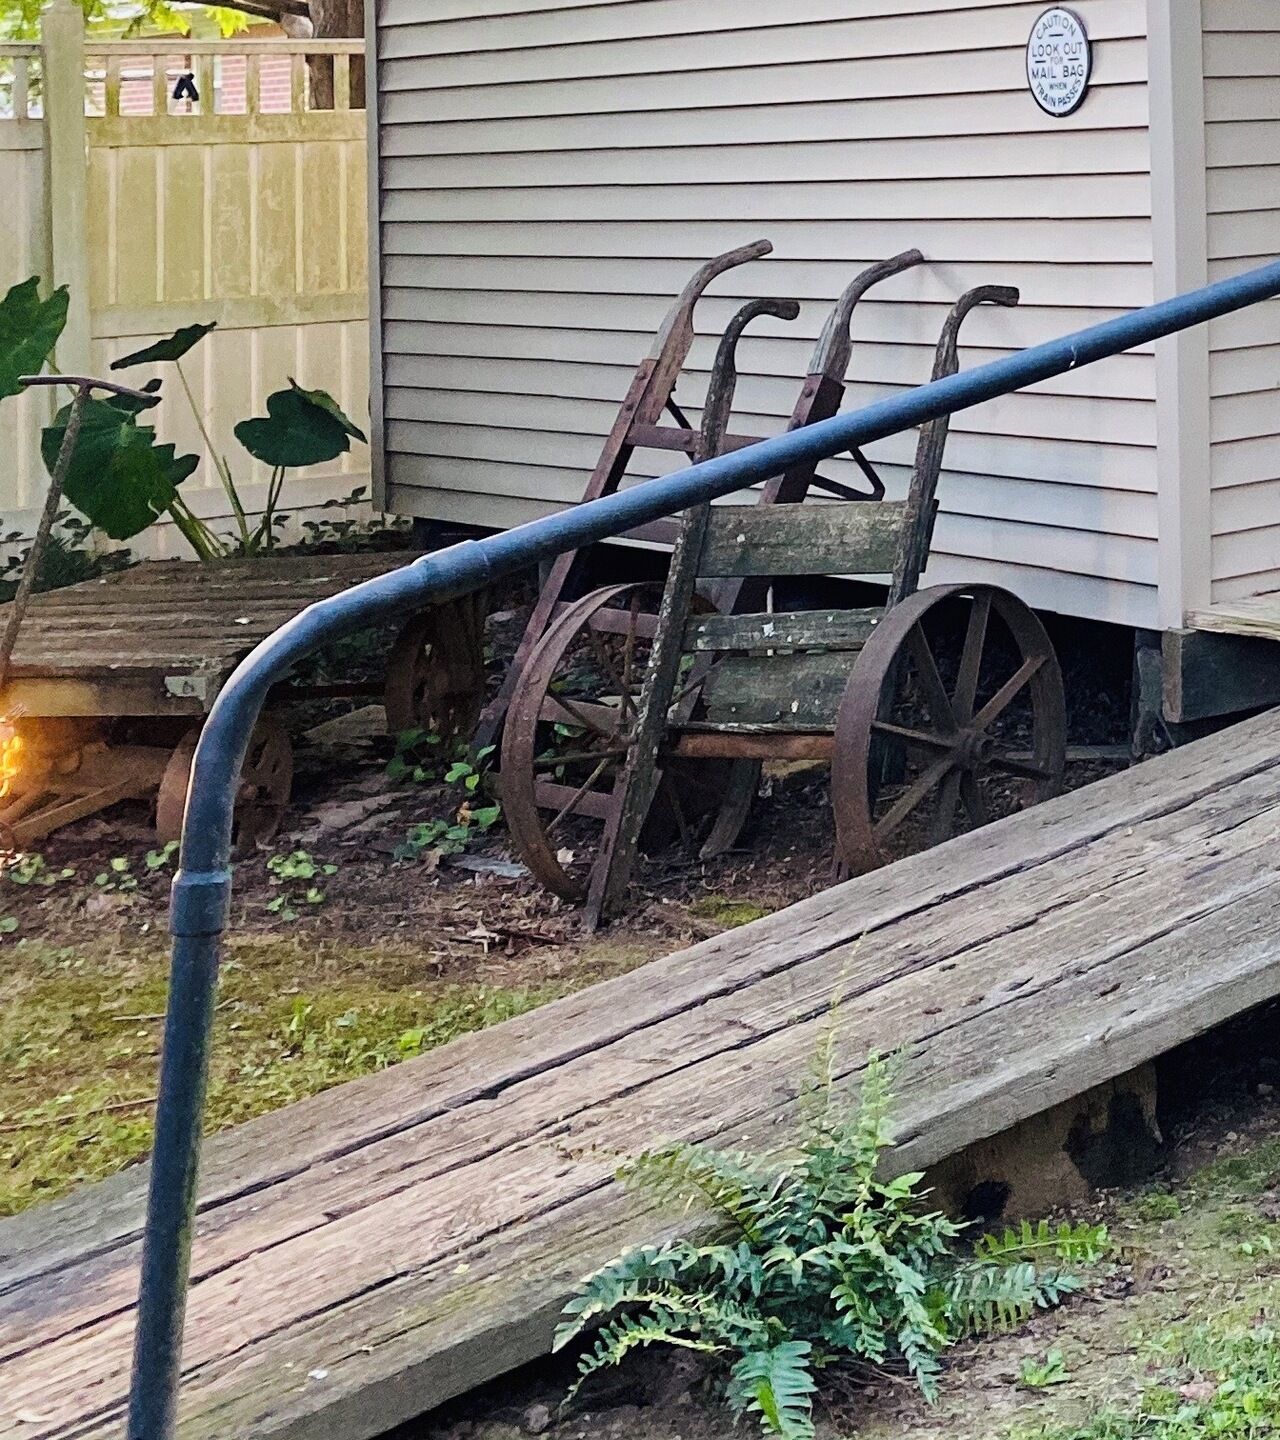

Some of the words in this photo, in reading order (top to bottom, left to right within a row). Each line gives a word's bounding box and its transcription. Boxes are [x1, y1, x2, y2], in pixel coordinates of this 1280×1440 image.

[1036, 14, 1077, 40] CAUTION
[1032, 43, 1059, 58] LOOK
[1064, 42, 1083, 55] OUT
[1050, 56, 1063, 64] FOR
[1031, 66, 1057, 80] MAIL
[1063, 64, 1084, 78] BAG
[1035, 82, 1056, 107] TRAIN
[1057, 78, 1082, 107] PASSES
[1049, 81, 1068, 91] WHEN
